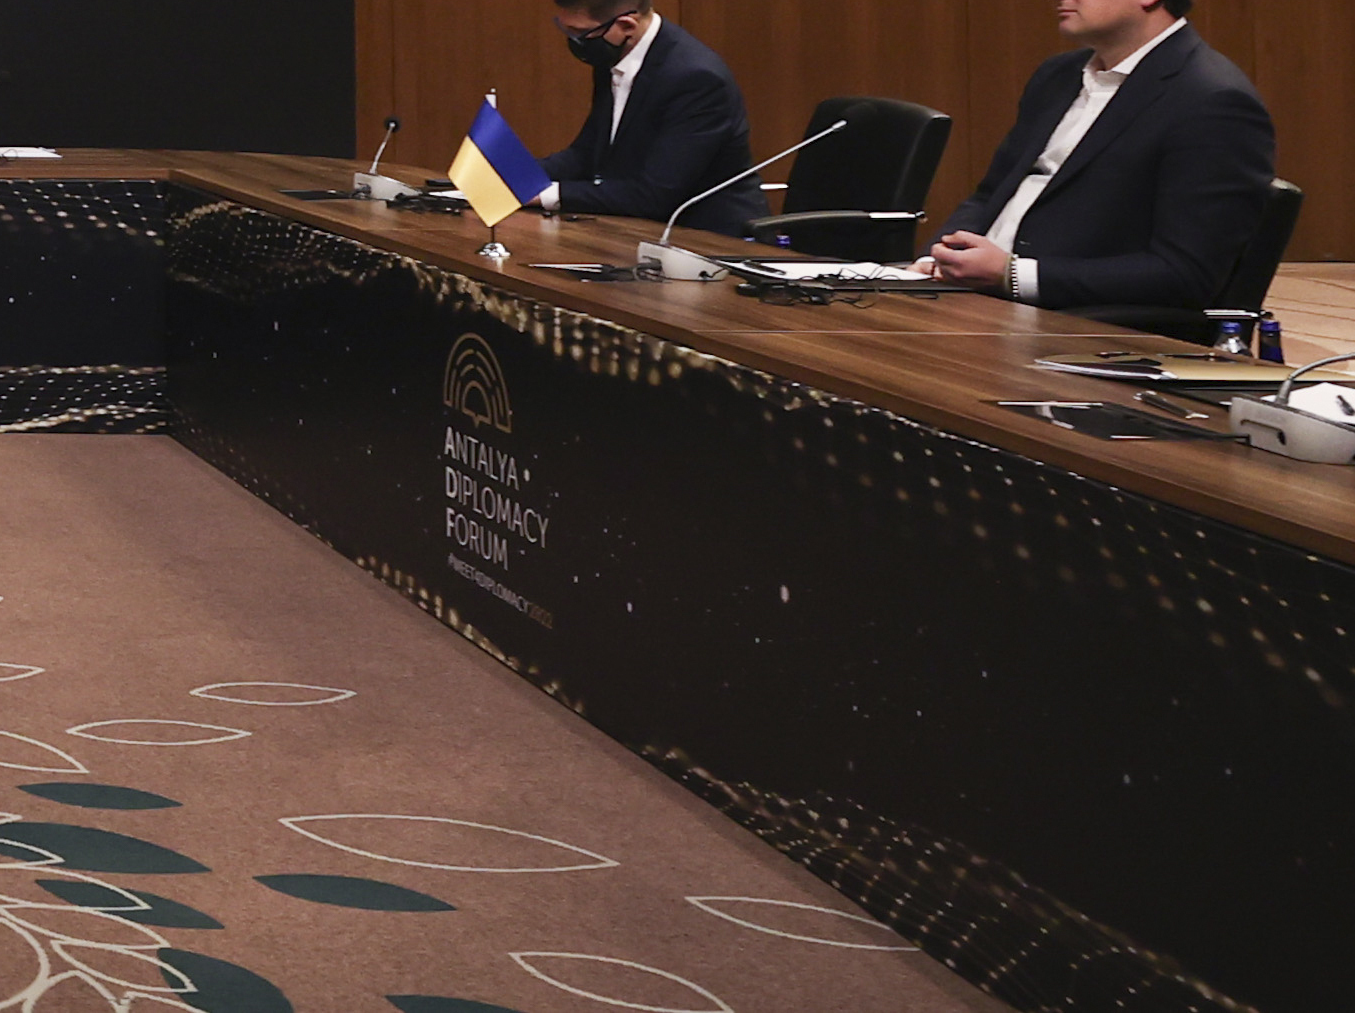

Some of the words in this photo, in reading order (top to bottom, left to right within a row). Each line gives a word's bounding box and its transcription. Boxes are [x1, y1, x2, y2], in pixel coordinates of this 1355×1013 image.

[444, 426, 519, 490] ANTALYA
[445, 467, 549, 548] DIPLOMACY
[446, 507, 509, 571] FORUM
